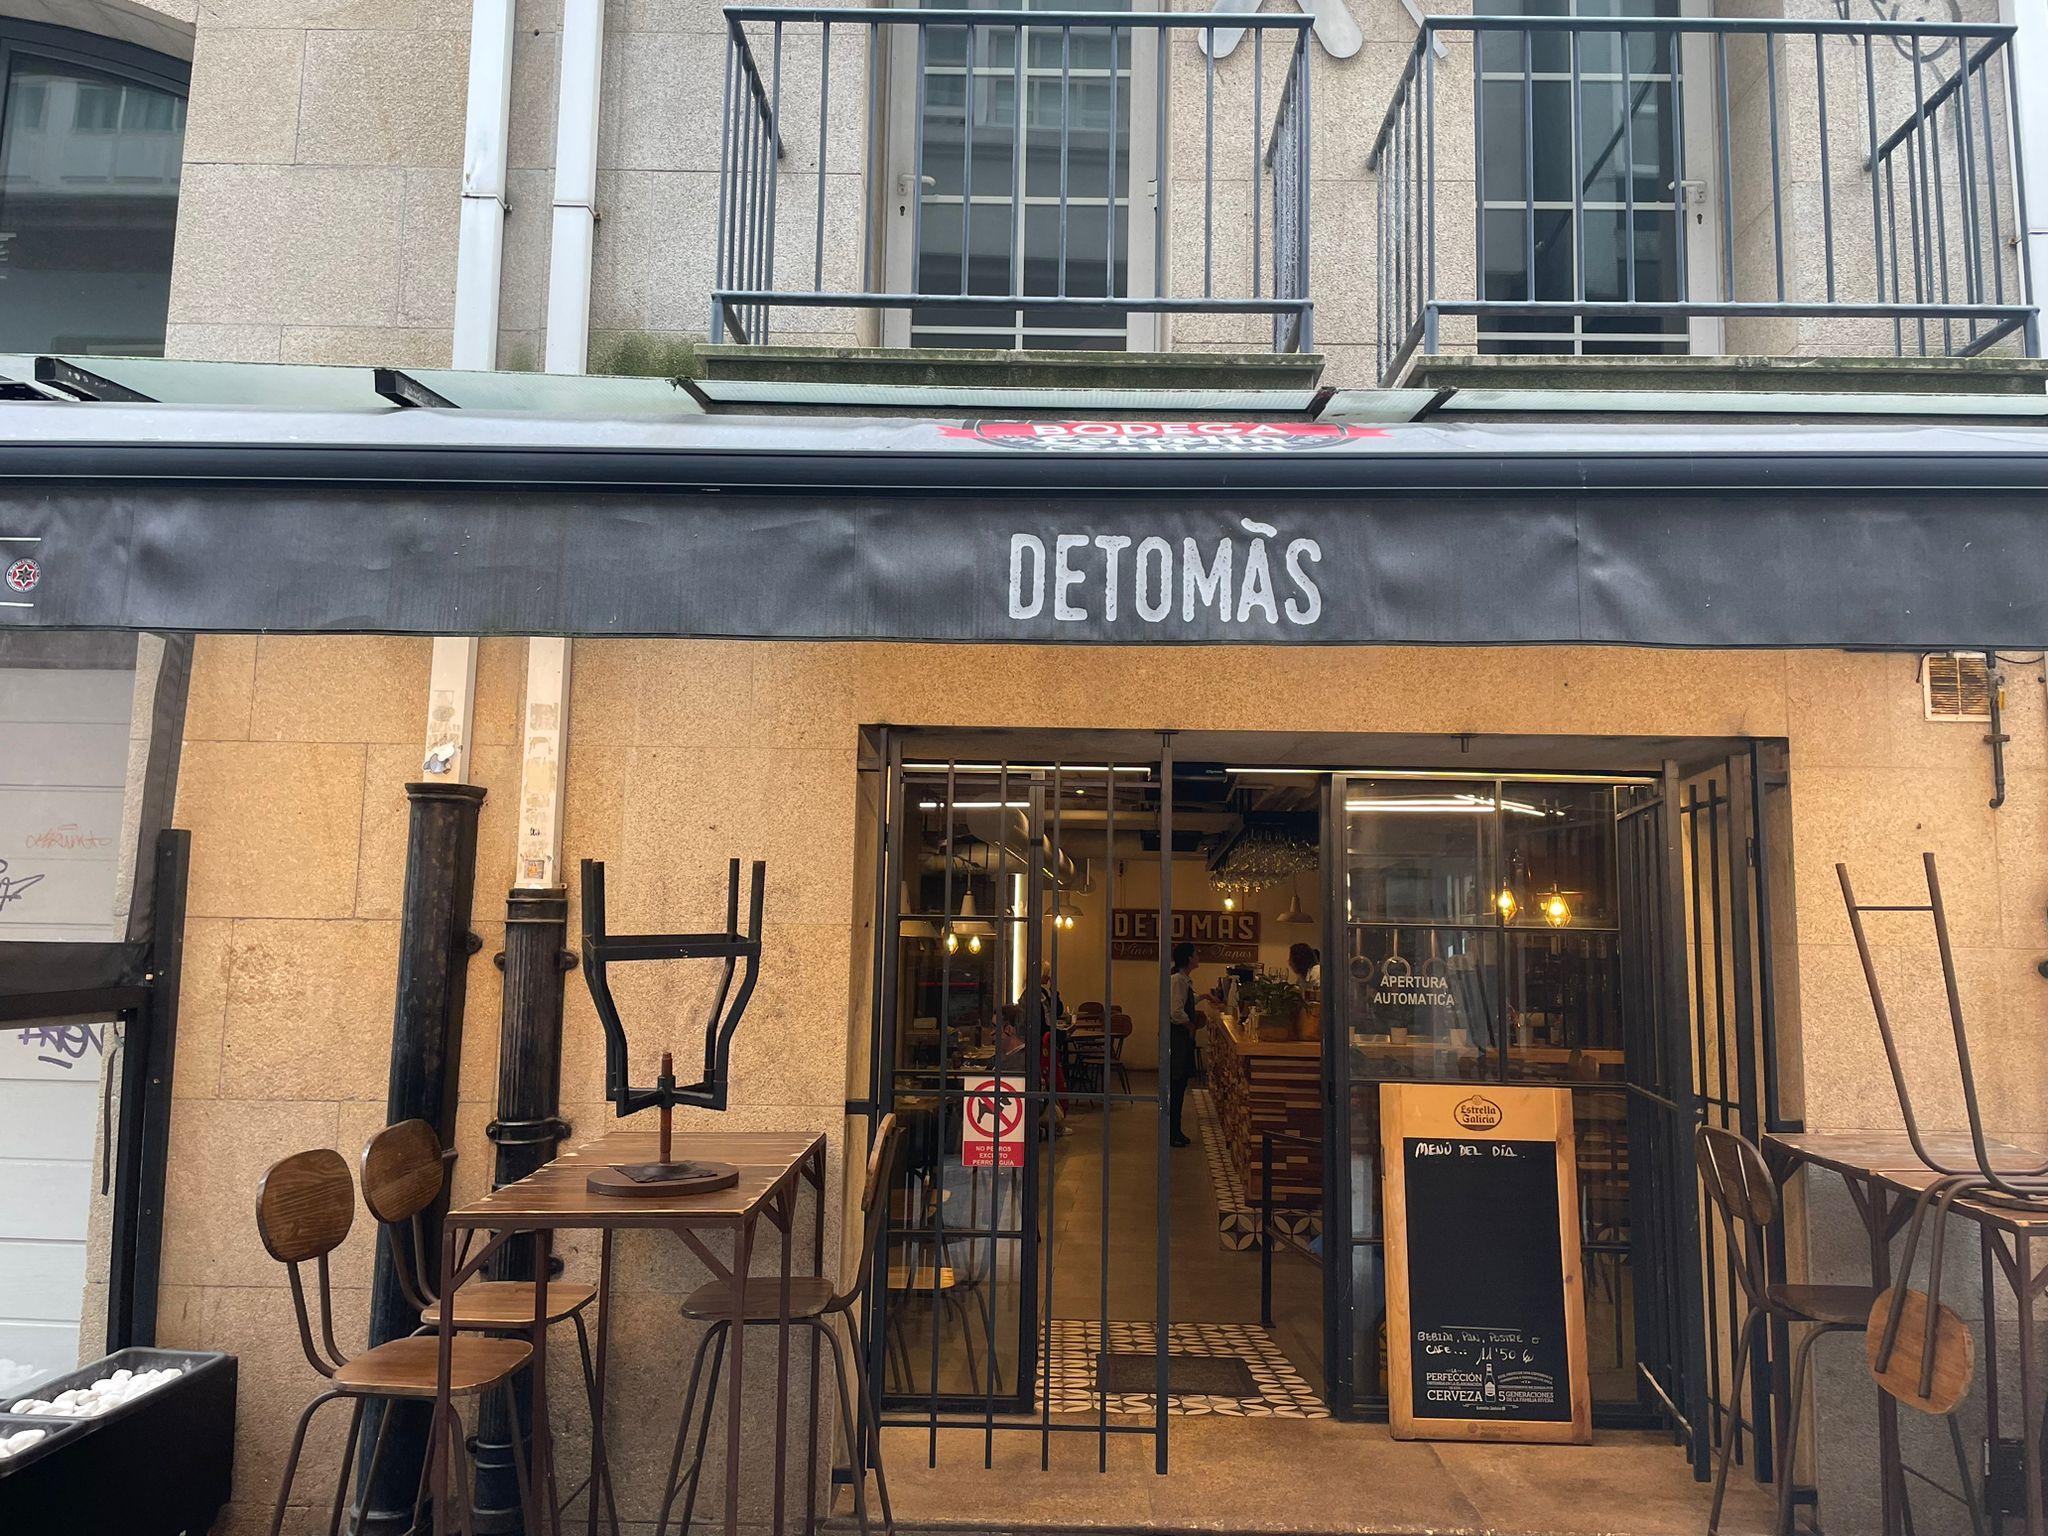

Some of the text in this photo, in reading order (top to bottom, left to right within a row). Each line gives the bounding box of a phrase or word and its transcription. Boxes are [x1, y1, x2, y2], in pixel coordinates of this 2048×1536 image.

[1033, 424, 1288, 435] BODEGA
[1380, 975, 1448, 989] APERTURA
[1374, 992, 1455, 1006] AUTOMATICA
[1460, 1105, 1497, 1115] Estrella
[1462, 1114, 1496, 1124] Galicia
[1459, 1144, 1483, 1157] DEL
[1426, 1372, 1483, 1382] PERFECCIÓN
[1427, 1390, 1484, 1402] CERVEZA
[1498, 1391, 1554, 1402] 5 GENERACIONES
